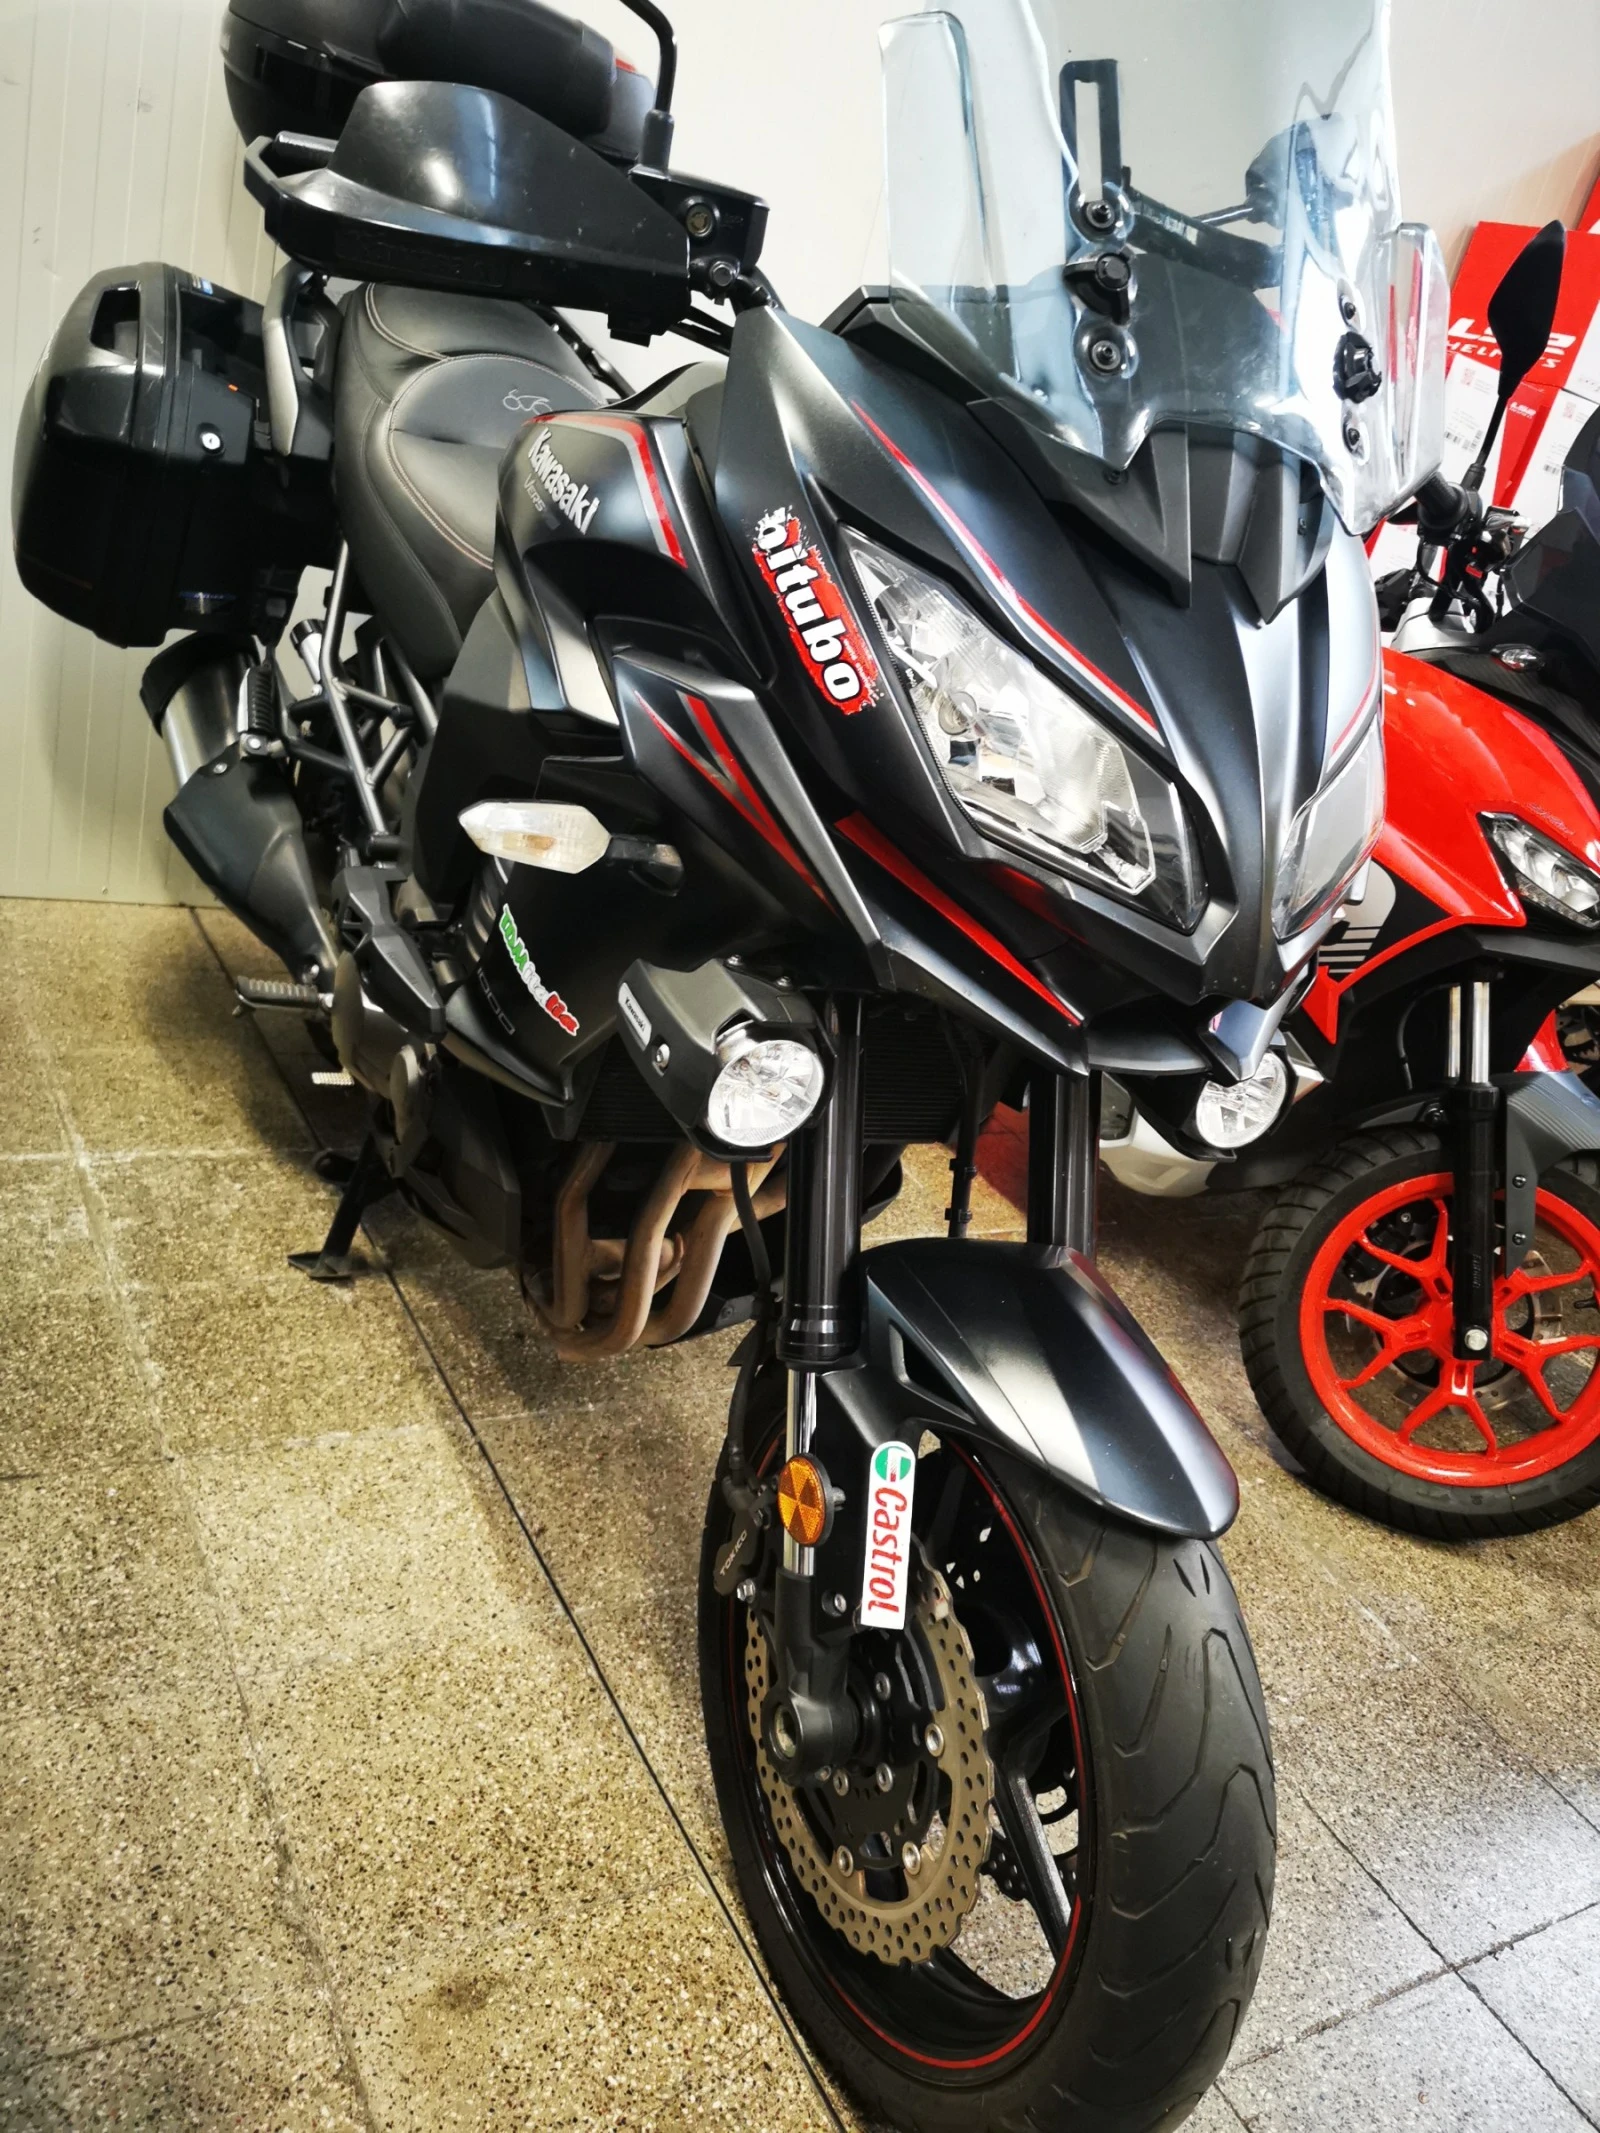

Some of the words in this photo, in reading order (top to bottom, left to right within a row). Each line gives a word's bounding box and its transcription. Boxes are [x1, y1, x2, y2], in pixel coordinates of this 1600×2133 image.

[1447, 341, 1561, 369] HELMS
[528, 427, 600, 535] Kawasaki
[757, 506, 861, 701] bitubo
[477, 967, 516, 1035] 1000
[719, 1529, 748, 1576] TOKICO
[868, 1487, 908, 1613] Castrol
